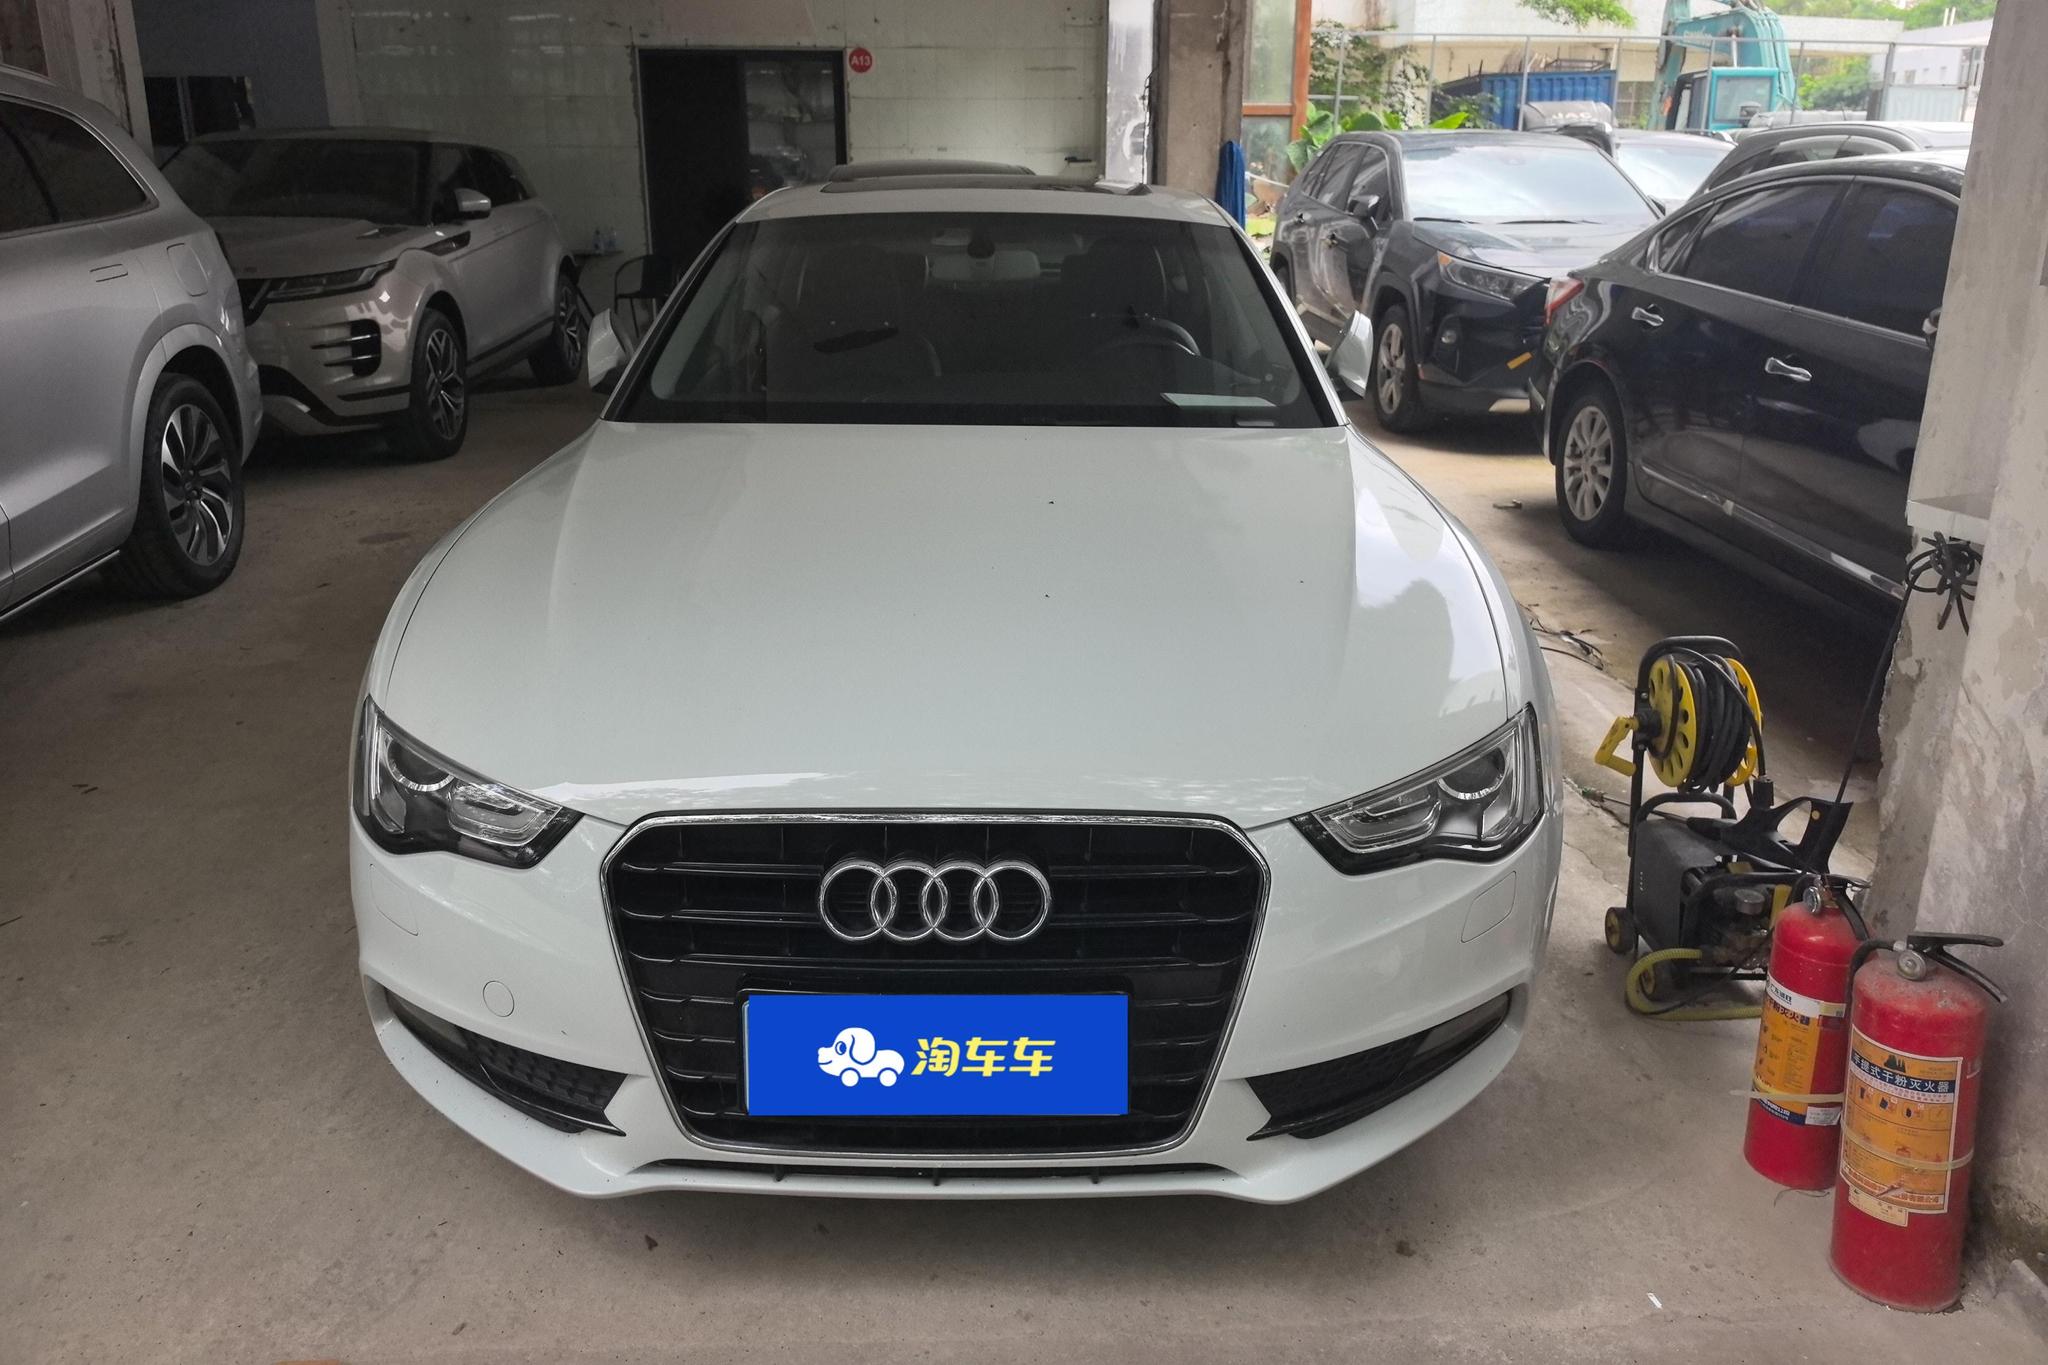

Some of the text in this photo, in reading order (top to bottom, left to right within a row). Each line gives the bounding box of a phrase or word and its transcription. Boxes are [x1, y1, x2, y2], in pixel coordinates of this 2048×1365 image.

[851, 55, 870, 66] A13
[1853, 1053, 1949, 1092] 手提式干粉灭火器
